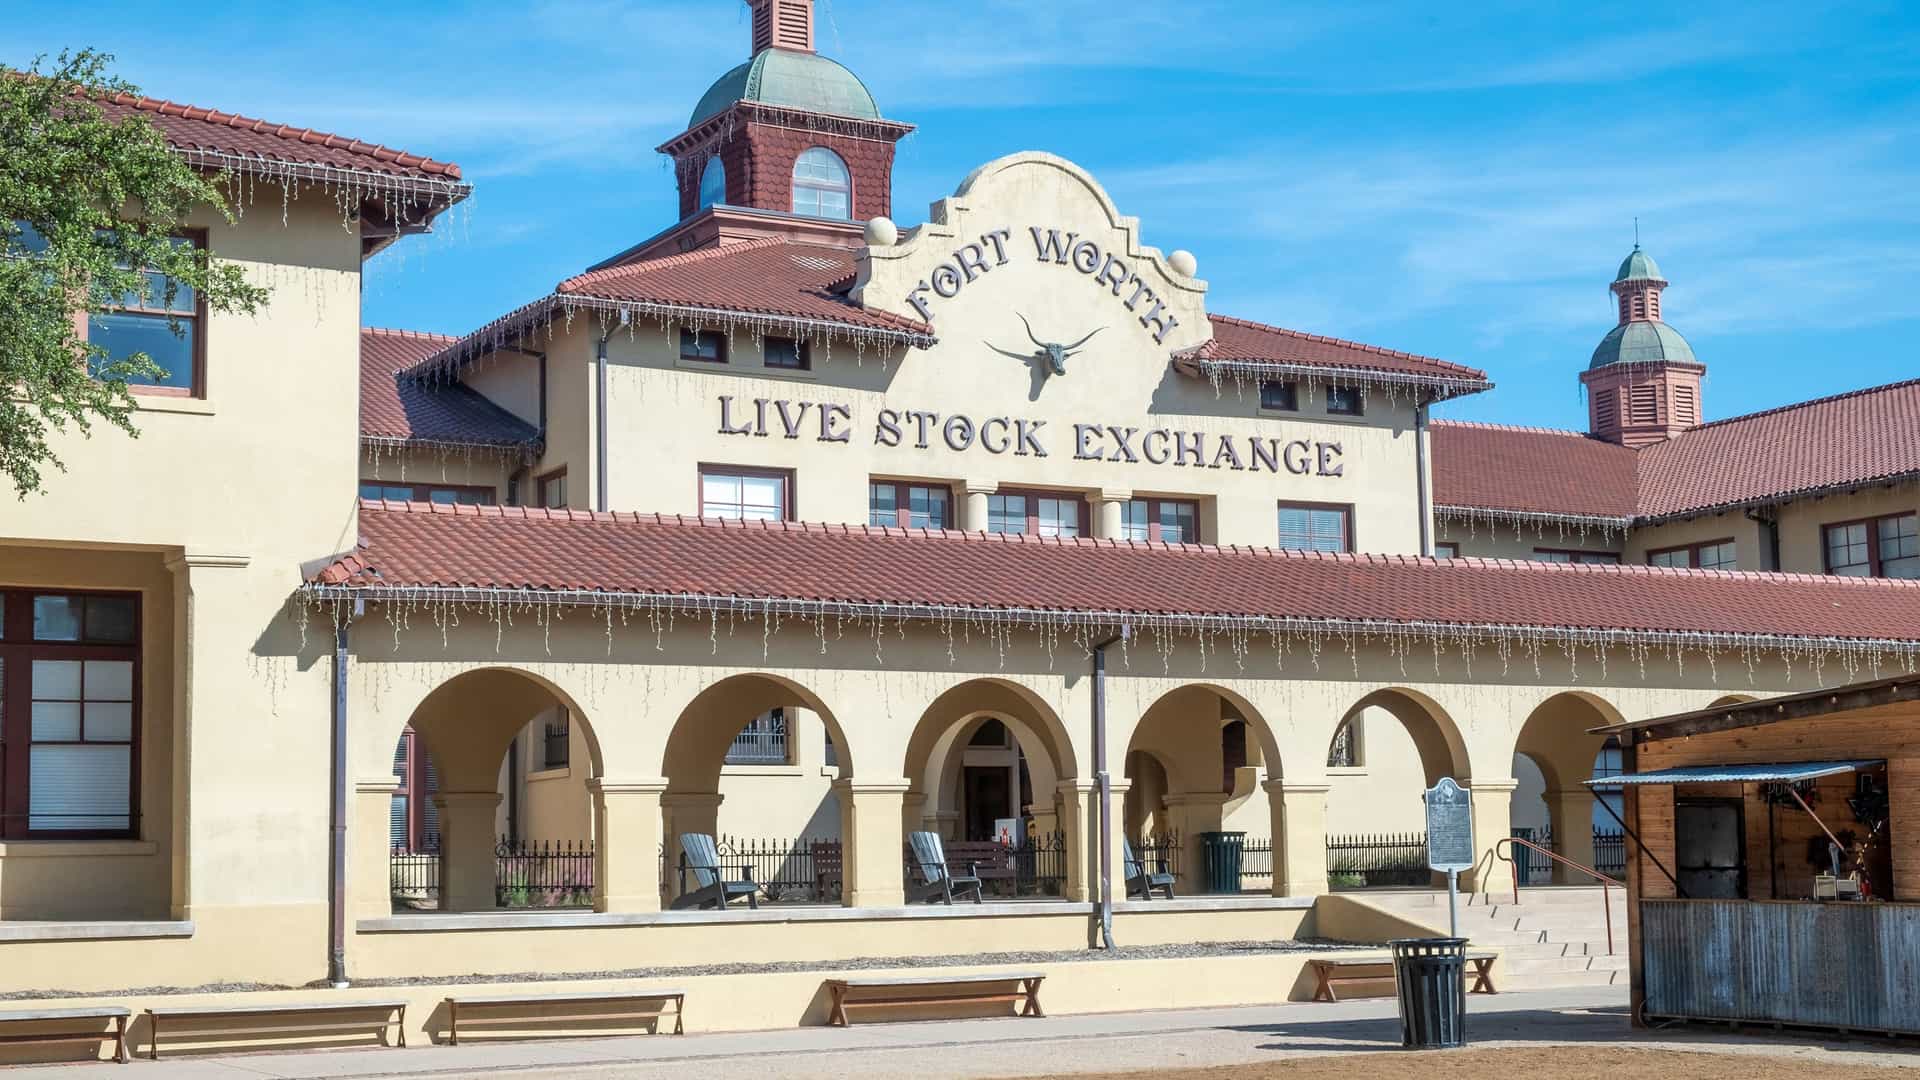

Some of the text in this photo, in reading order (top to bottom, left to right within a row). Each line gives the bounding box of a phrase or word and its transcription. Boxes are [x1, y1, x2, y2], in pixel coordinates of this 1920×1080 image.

[905, 226, 1179, 345] FORT WORTH
[717, 395, 1344, 477] LIVE STOCK EXCHANGE
